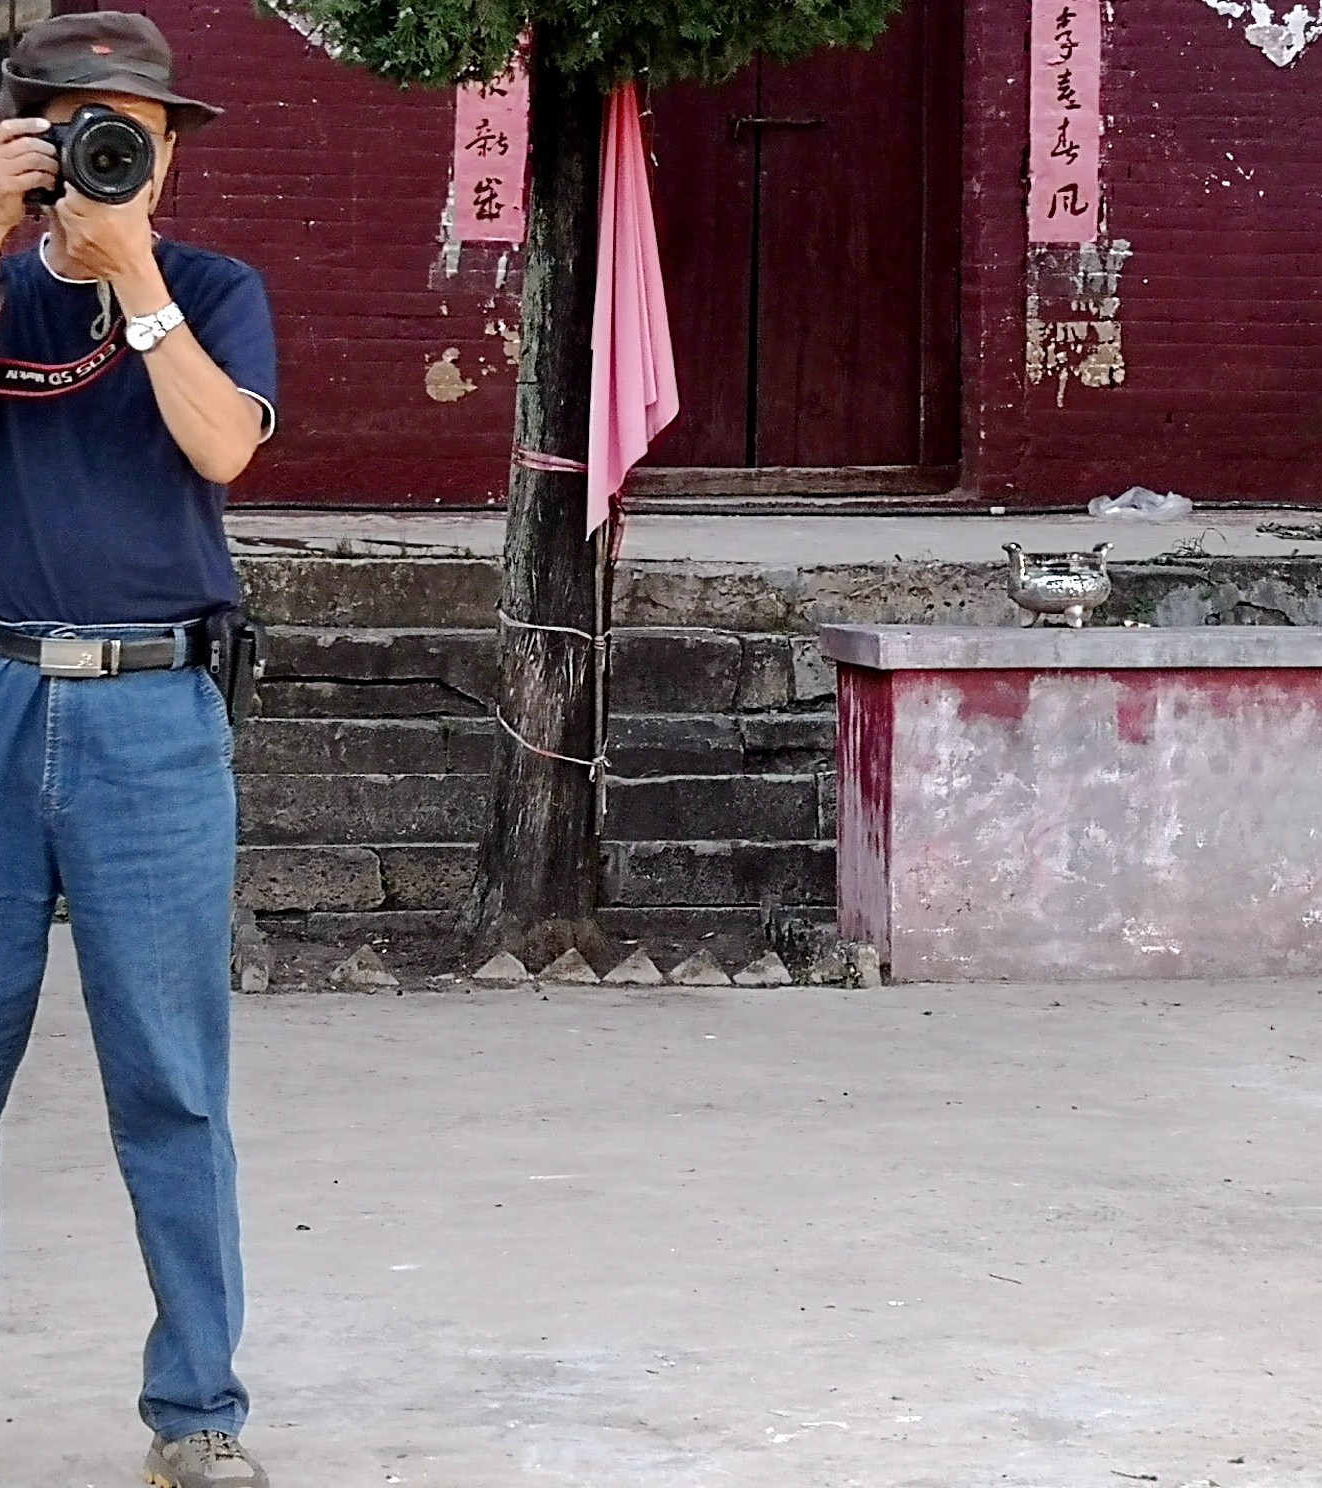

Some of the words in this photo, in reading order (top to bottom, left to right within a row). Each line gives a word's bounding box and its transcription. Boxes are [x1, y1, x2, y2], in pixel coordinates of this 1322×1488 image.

[75, 343, 117, 378] EOS
[5, 369, 19, 380] IV
[19, 370, 45, 384] Mark
[48, 370, 74, 386] 5D
